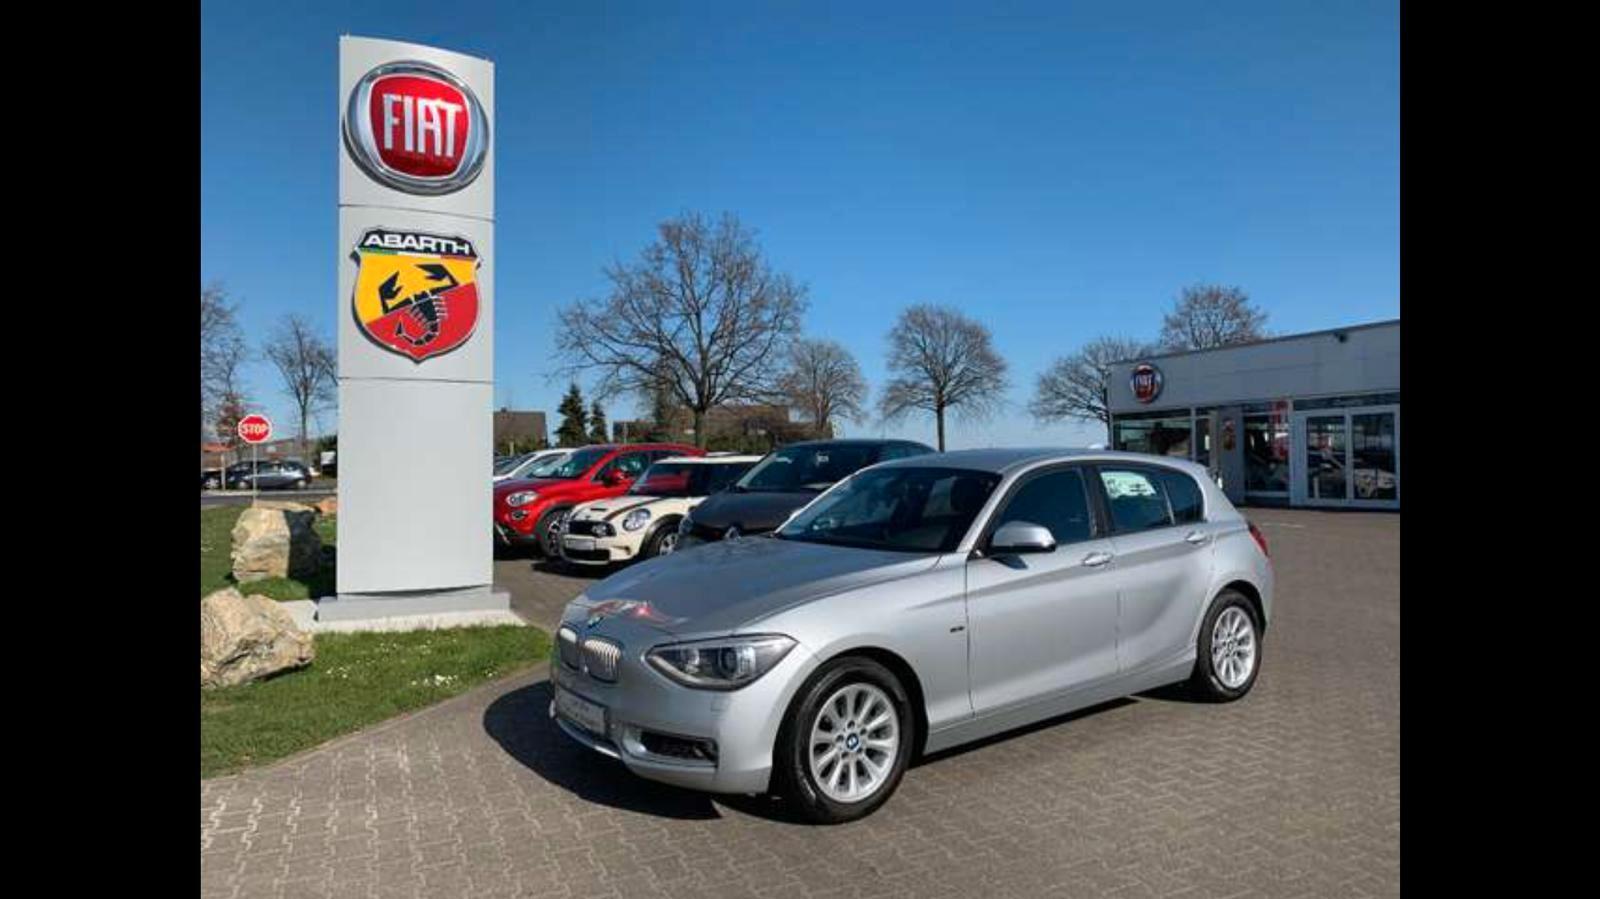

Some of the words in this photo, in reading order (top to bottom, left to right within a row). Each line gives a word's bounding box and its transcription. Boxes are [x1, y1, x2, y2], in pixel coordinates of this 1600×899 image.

[383, 93, 462, 157] FIAT
[364, 233, 470, 254] ABARTH
[1135, 373, 1153, 388] FIAT
[241, 423, 267, 435] STOP
